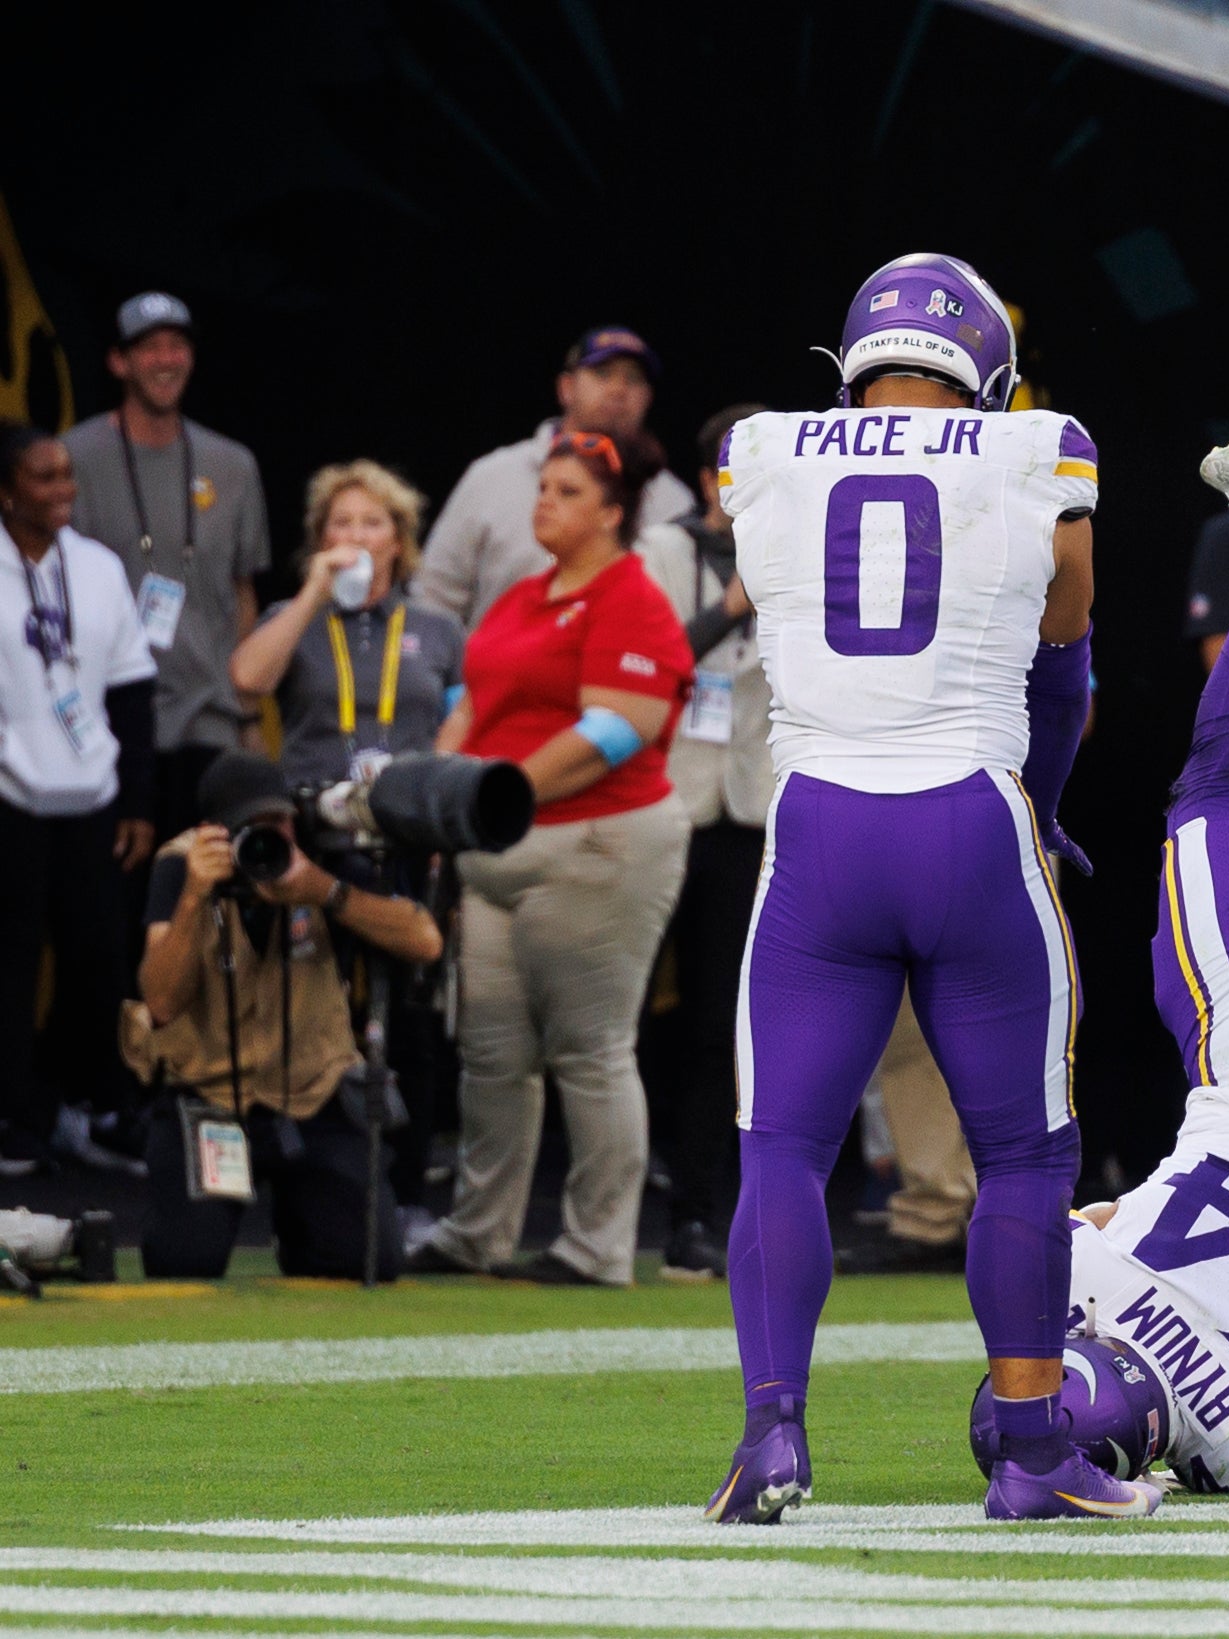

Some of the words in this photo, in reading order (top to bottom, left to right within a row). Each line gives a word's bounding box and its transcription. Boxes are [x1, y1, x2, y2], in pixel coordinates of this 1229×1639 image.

[947, 301, 964, 317] KJ
[859, 343, 868, 353] IT
[870, 337, 899, 349] TAKES
[903, 337, 922, 347] ALL
[925, 341, 939, 351] OF
[941, 346, 955, 358] US
[794, 415, 911, 457] PACE
[923, 418, 984, 456] JR
[824, 473, 942, 657] 0
